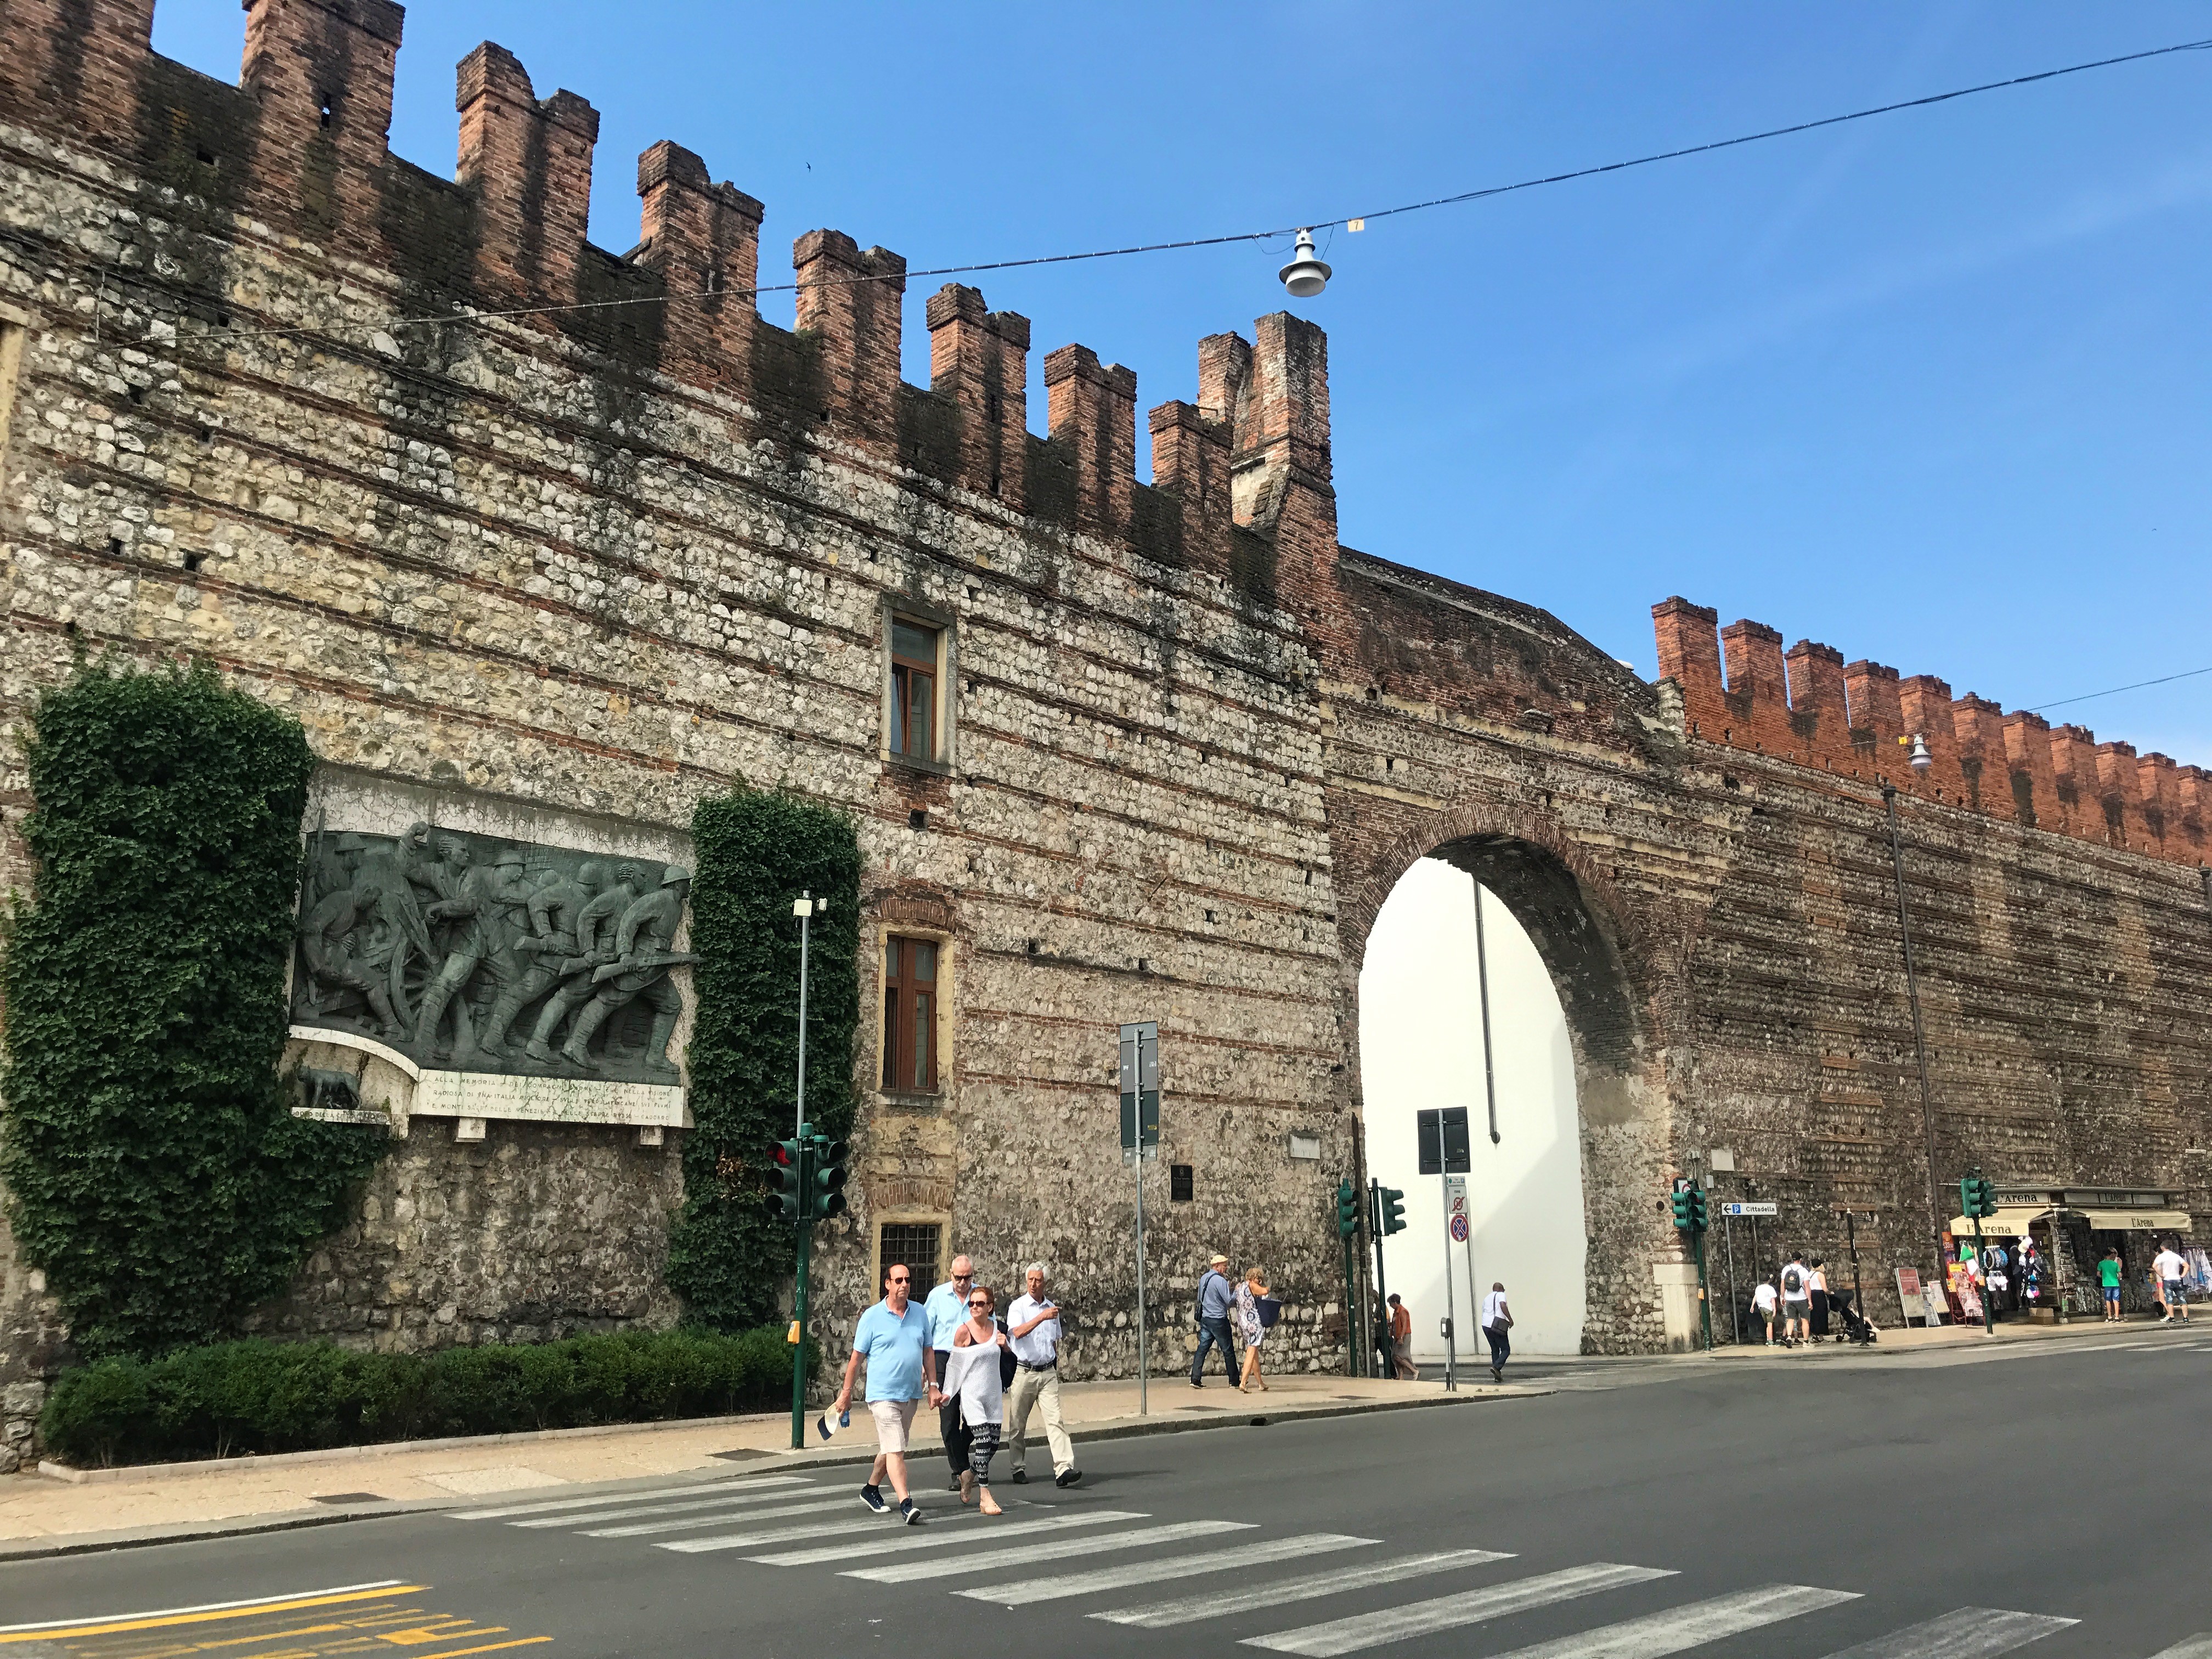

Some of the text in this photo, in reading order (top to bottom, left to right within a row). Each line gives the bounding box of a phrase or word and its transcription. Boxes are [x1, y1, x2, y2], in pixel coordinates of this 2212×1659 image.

[476, 810, 544, 831] DIVSIONE
[624, 838, 645, 848] 1866
[1996, 1194, 2038, 1203] L'Arena
[2131, 1218, 2154, 1228] L'Arena
